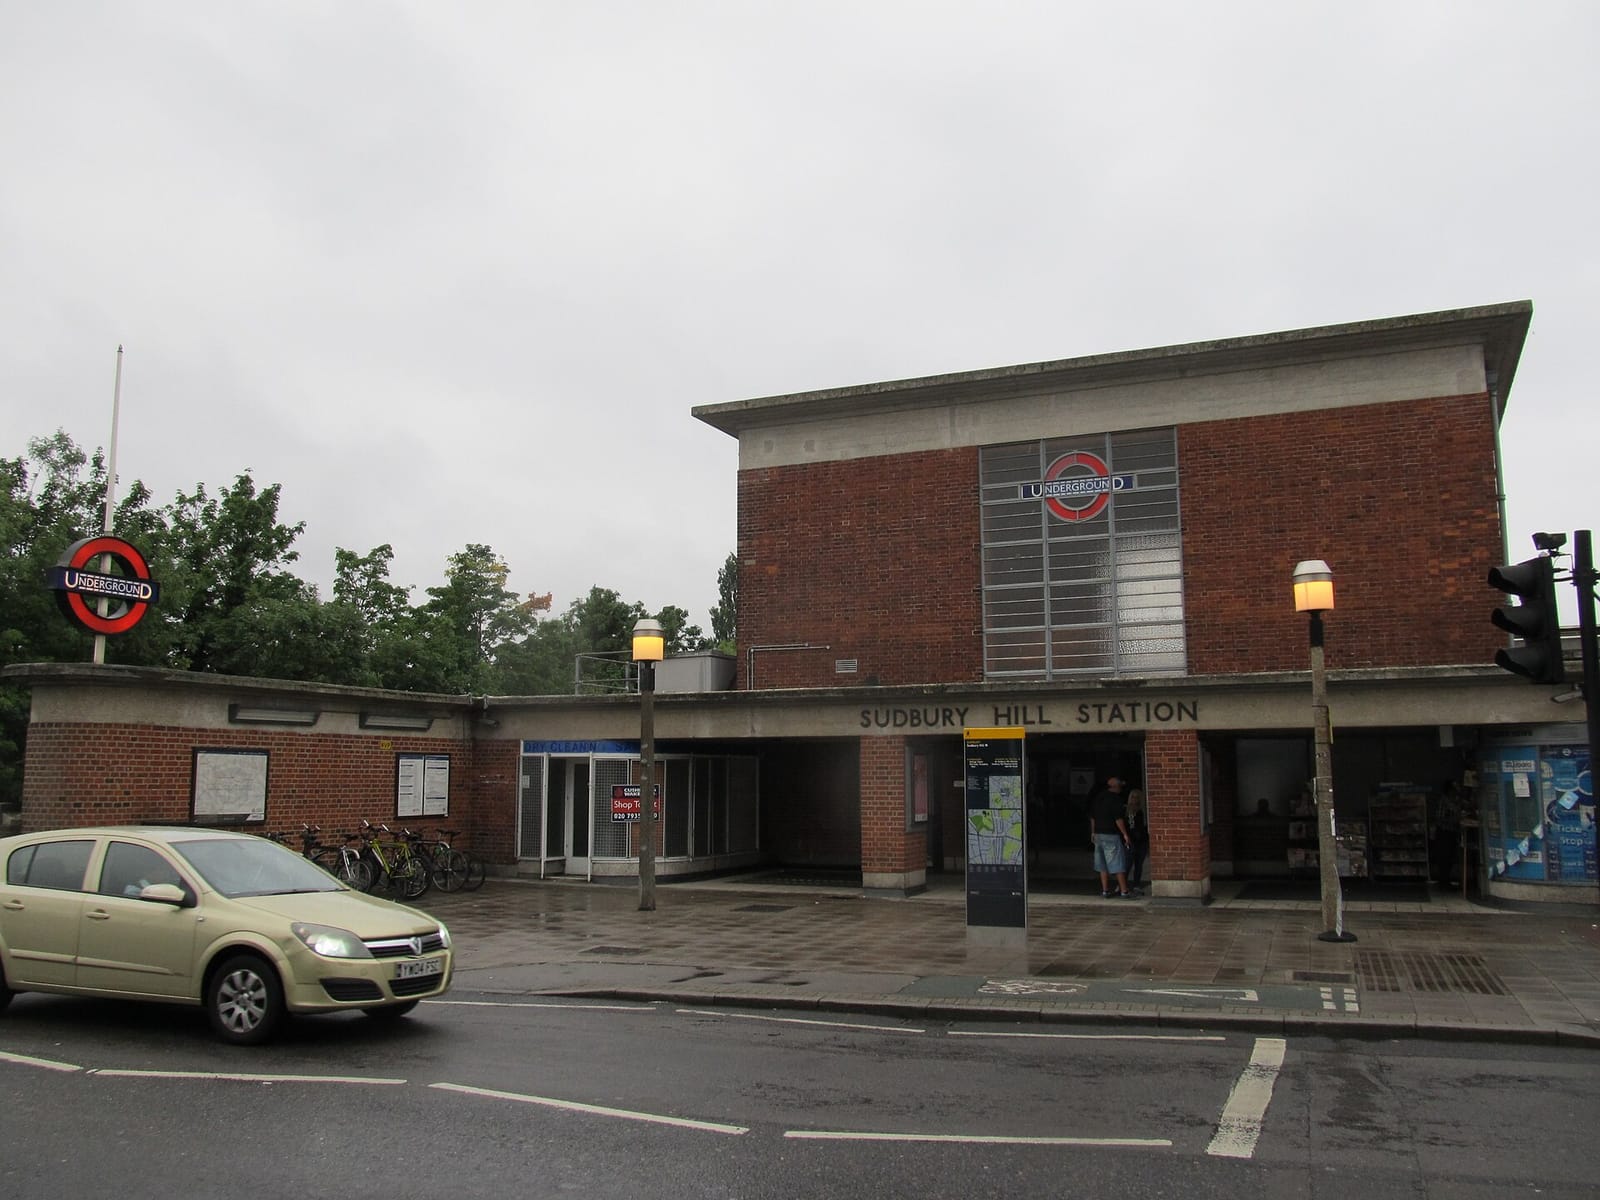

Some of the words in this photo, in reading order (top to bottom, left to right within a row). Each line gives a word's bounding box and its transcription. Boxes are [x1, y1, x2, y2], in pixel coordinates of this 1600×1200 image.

[1031, 478, 1123, 497] UNDERGROUND
[65, 571, 151, 599] UNDERGROUND
[861, 706, 968, 729] SUDBURY
[994, 705, 1051, 727] HILL
[1079, 701, 1198, 725] STATION
[614, 800, 632, 811] Shop
